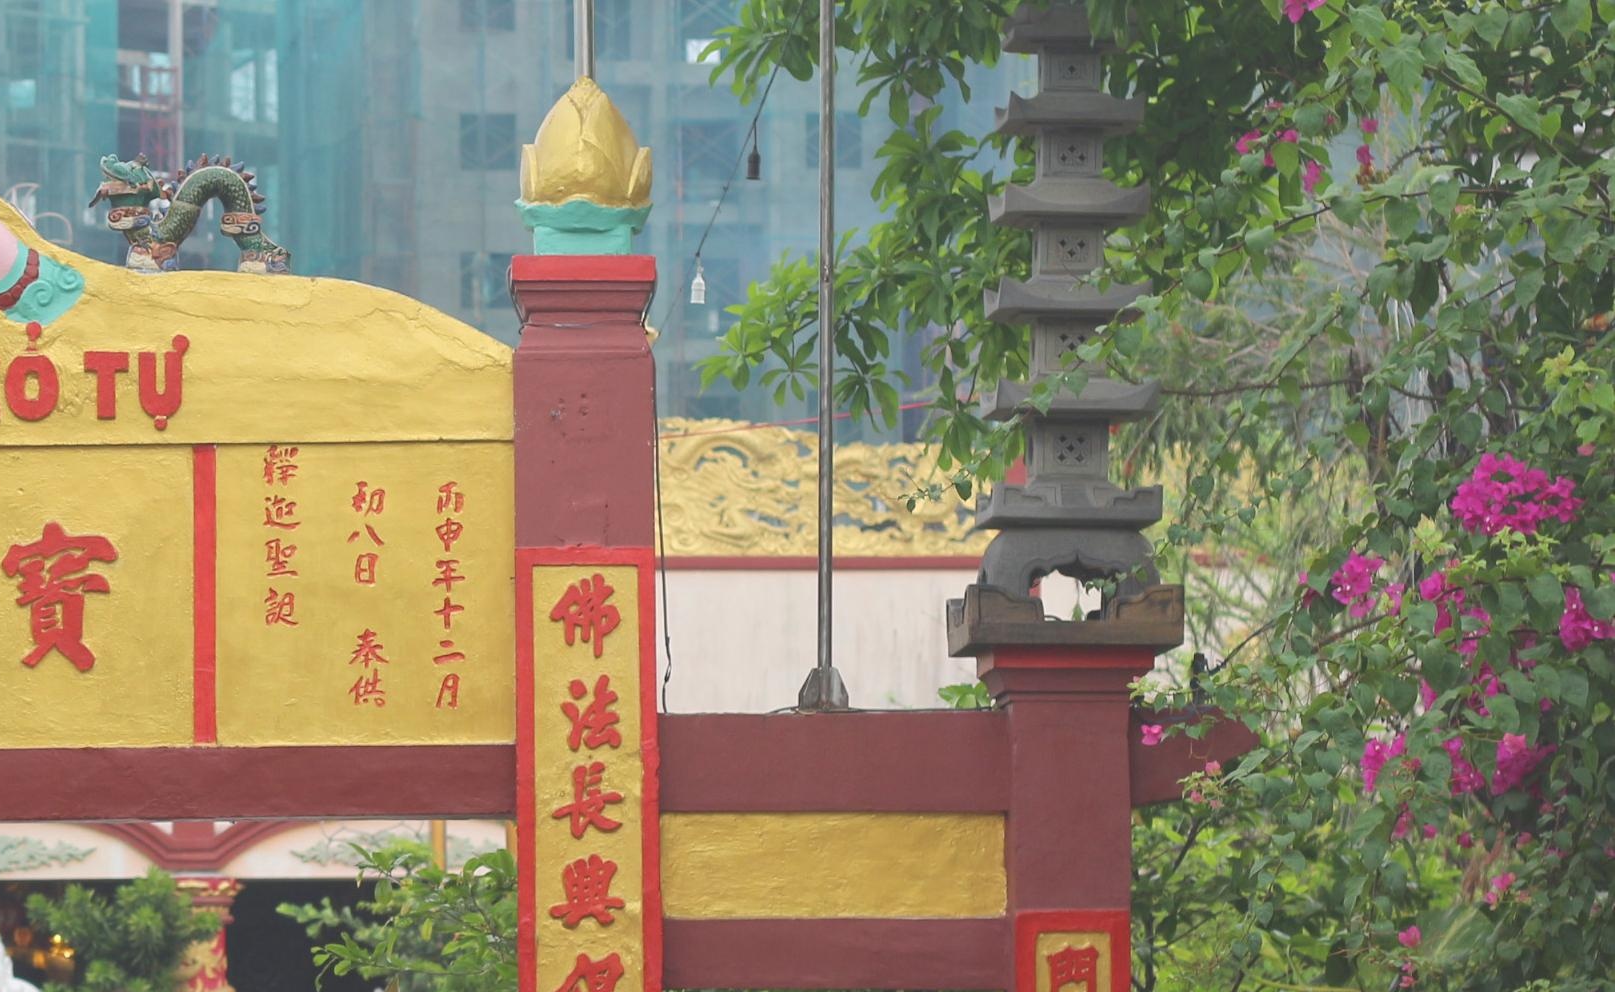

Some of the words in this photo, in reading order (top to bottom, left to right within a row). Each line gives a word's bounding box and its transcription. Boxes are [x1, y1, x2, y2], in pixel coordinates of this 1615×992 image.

[83, 334, 190, 431] TỰ
[432, 480, 466, 709] 丙申年十二月
